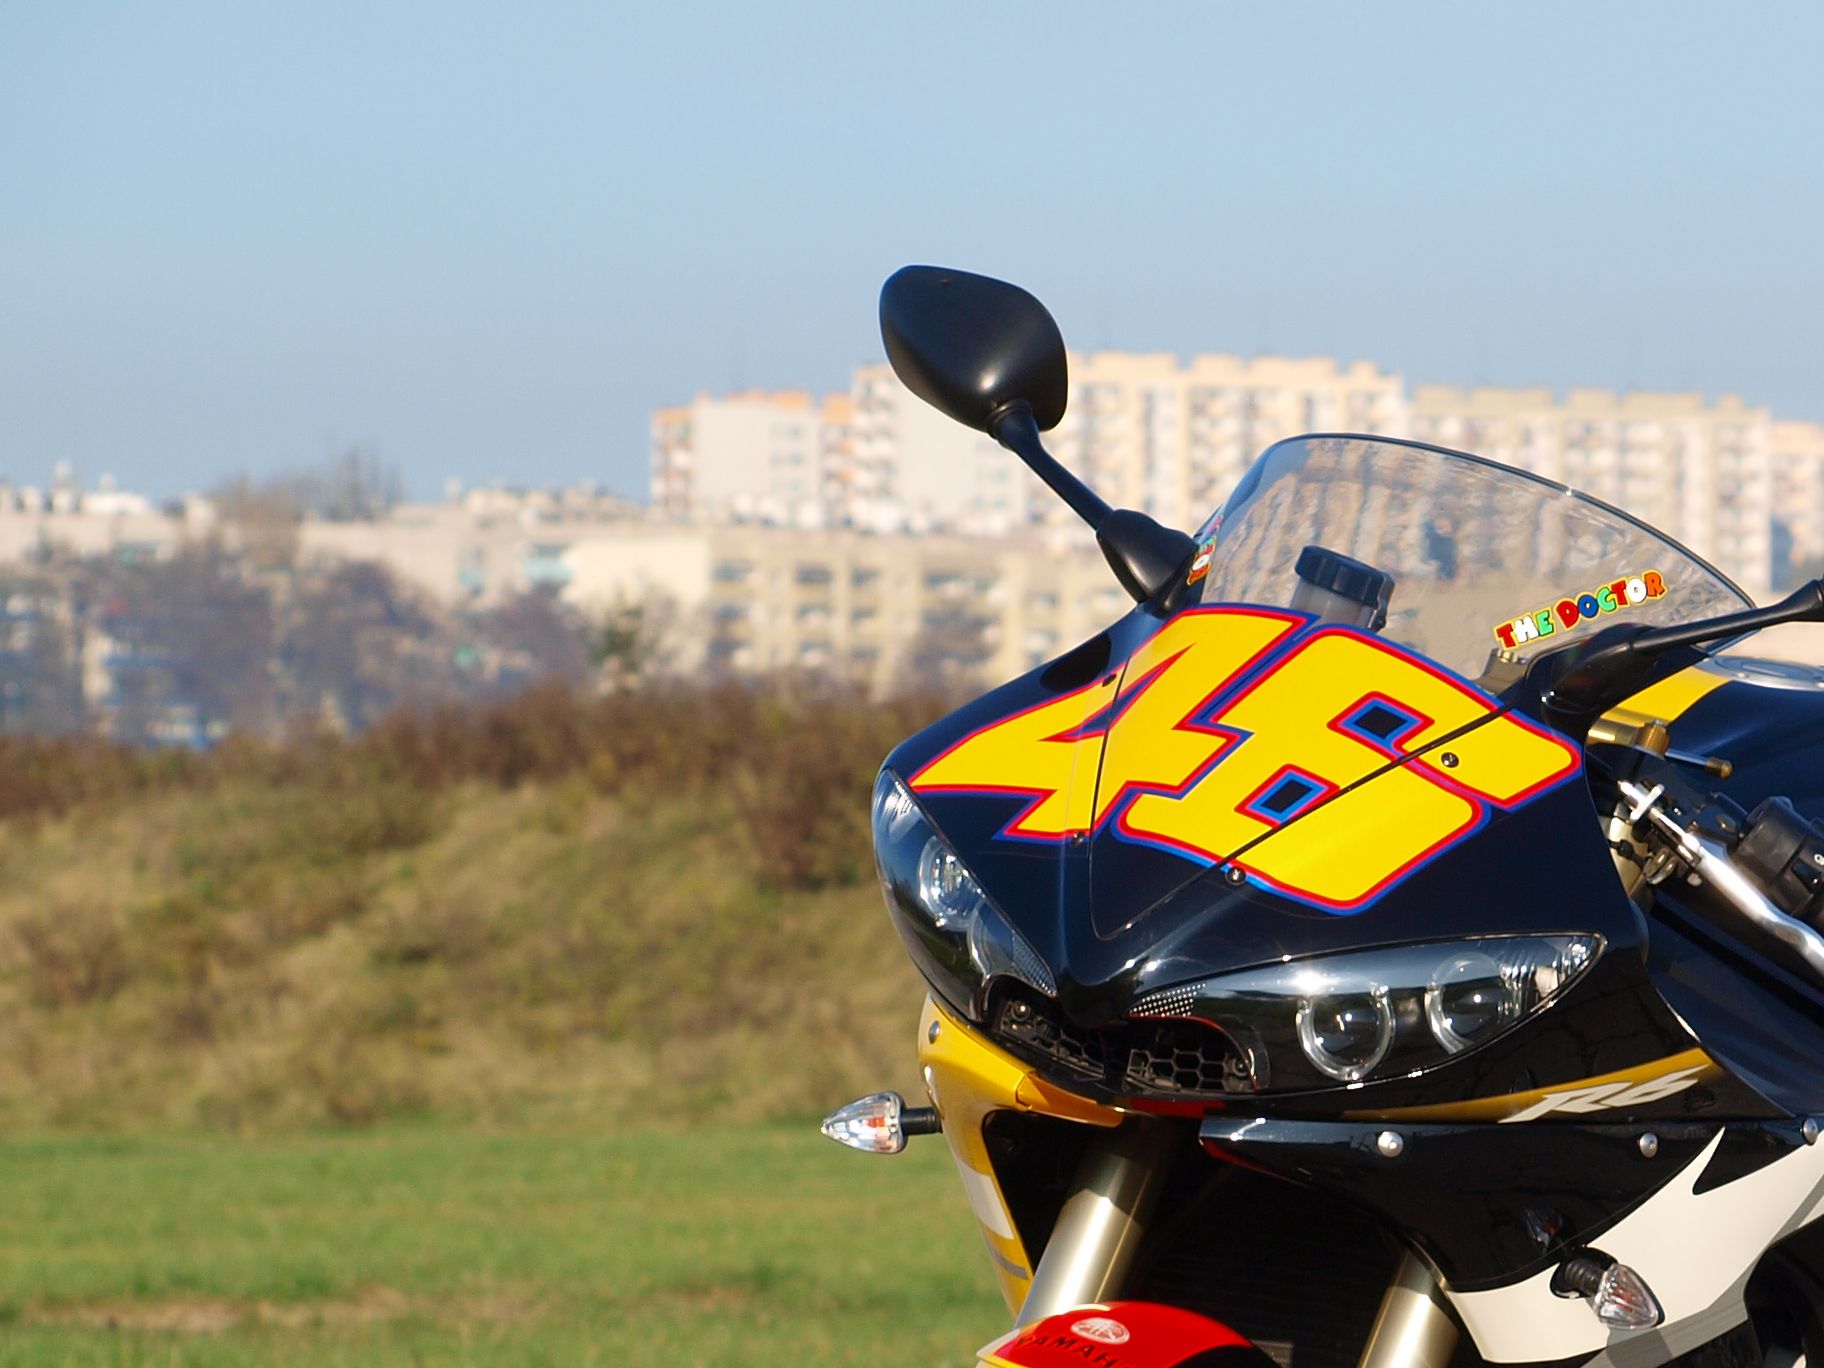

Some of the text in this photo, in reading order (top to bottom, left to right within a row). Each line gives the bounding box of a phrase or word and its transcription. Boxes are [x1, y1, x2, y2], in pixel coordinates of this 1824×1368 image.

[1495, 570, 1667, 649] THE DOCTOR
[908, 604, 1583, 916] 46
[1497, 1064, 1710, 1124] R6
